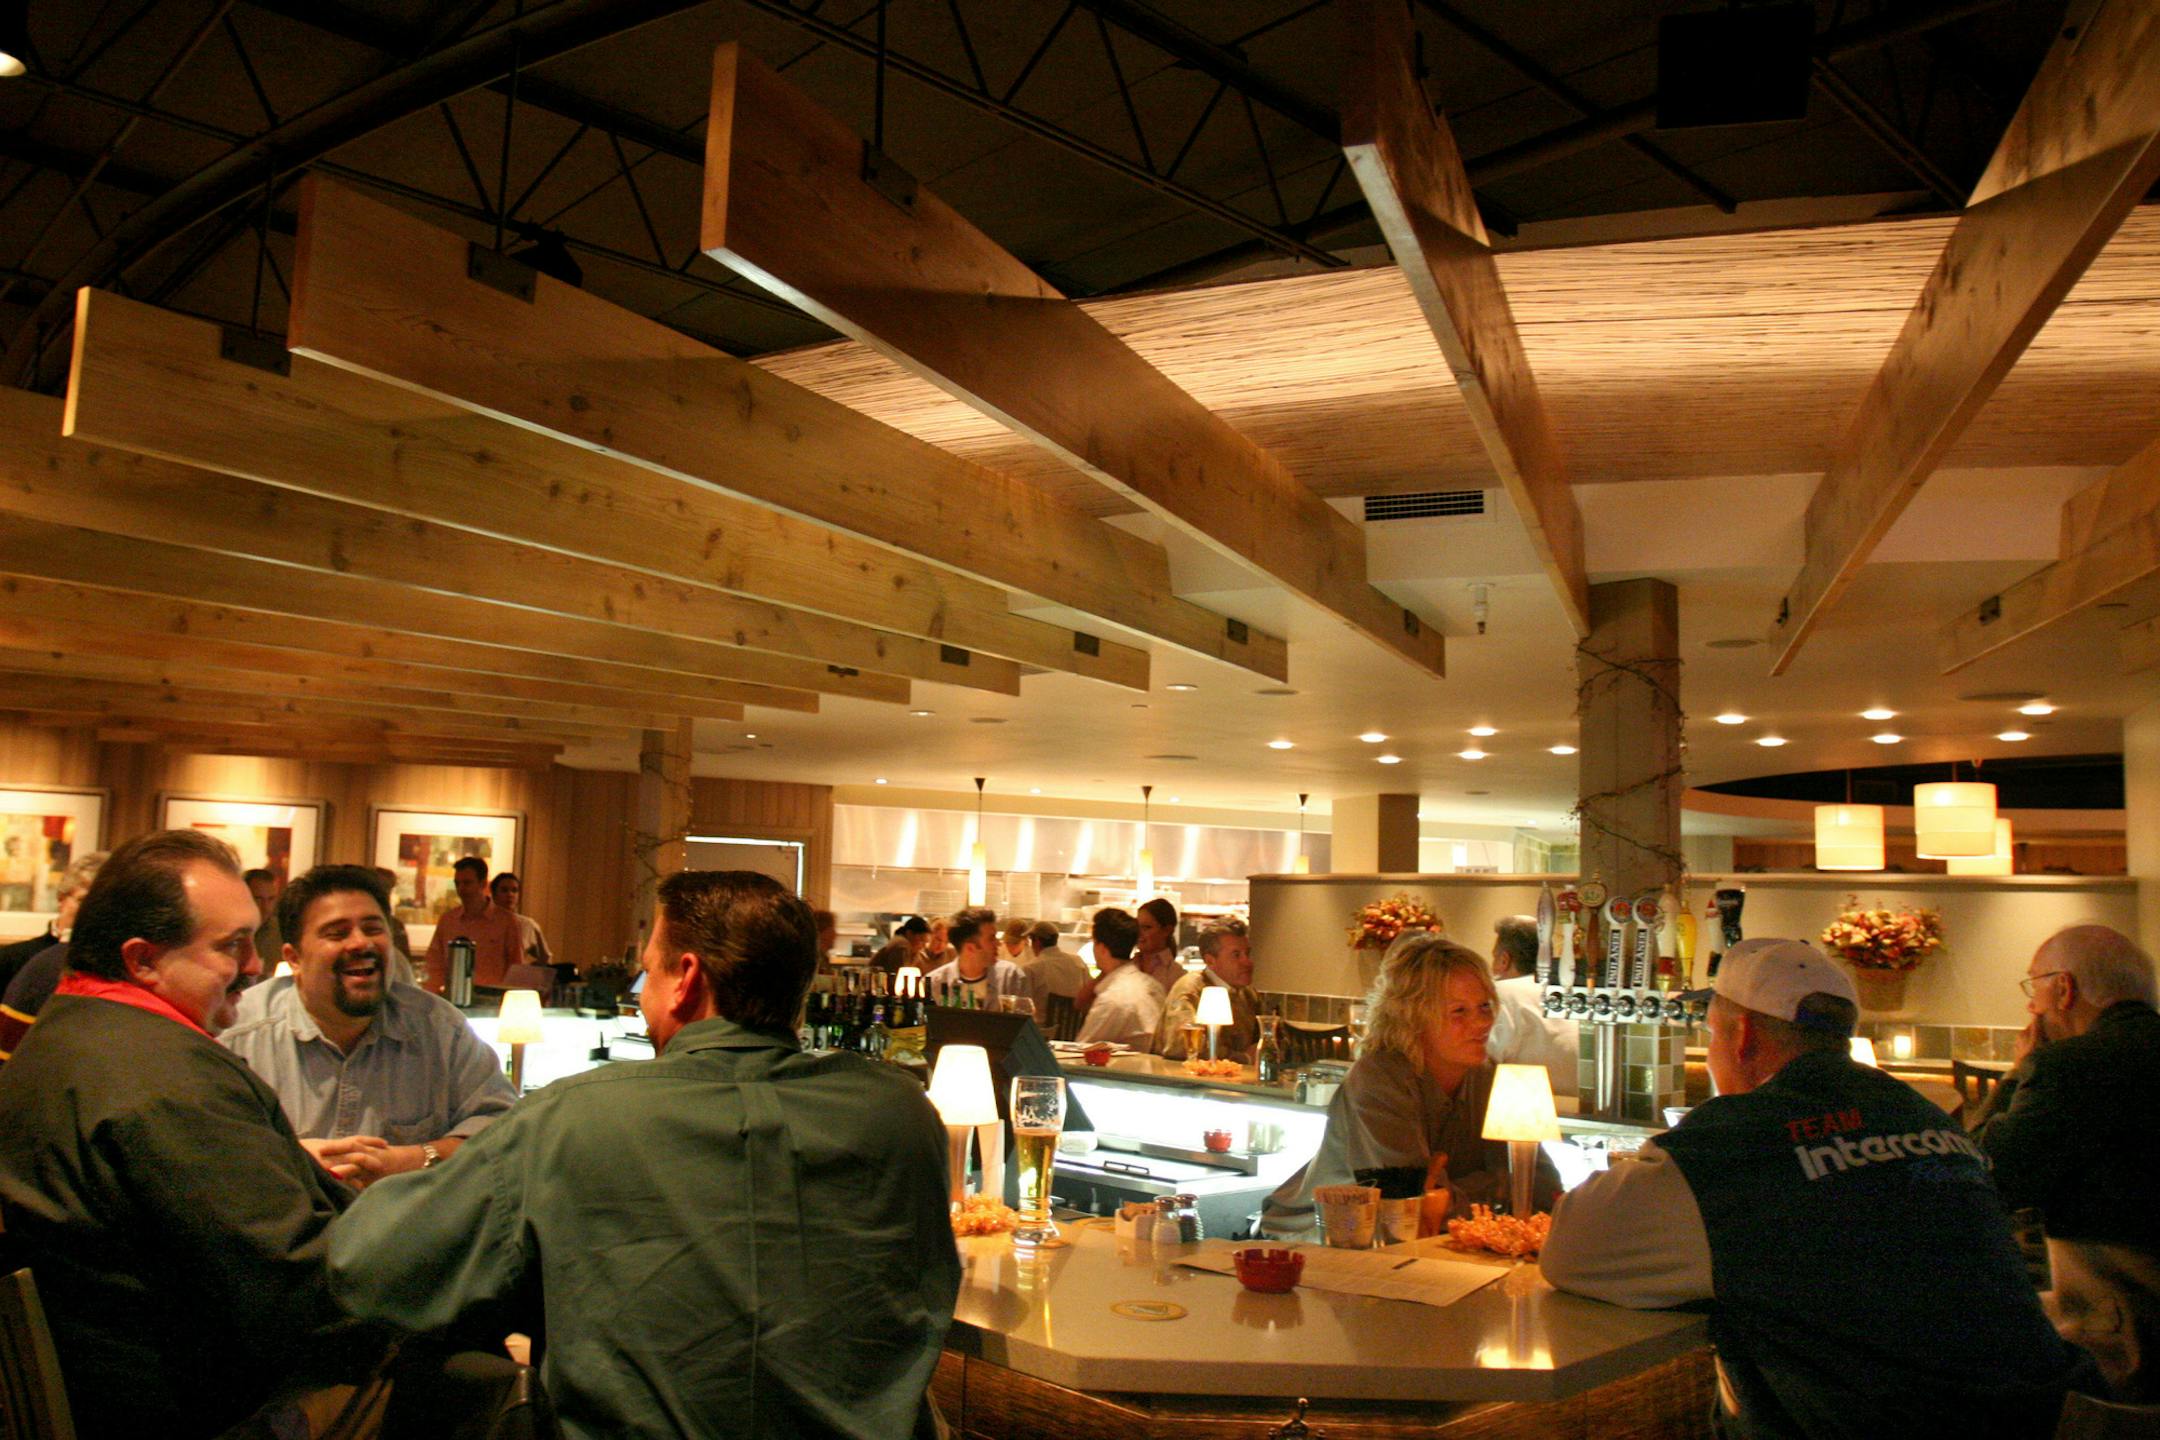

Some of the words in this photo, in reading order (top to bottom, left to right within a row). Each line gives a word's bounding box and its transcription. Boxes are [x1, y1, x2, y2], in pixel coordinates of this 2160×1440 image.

[1608, 931, 1621, 985] PAULANER
[1633, 931, 1647, 984] PAULANER
[1786, 1107, 1866, 1141] TEAM
